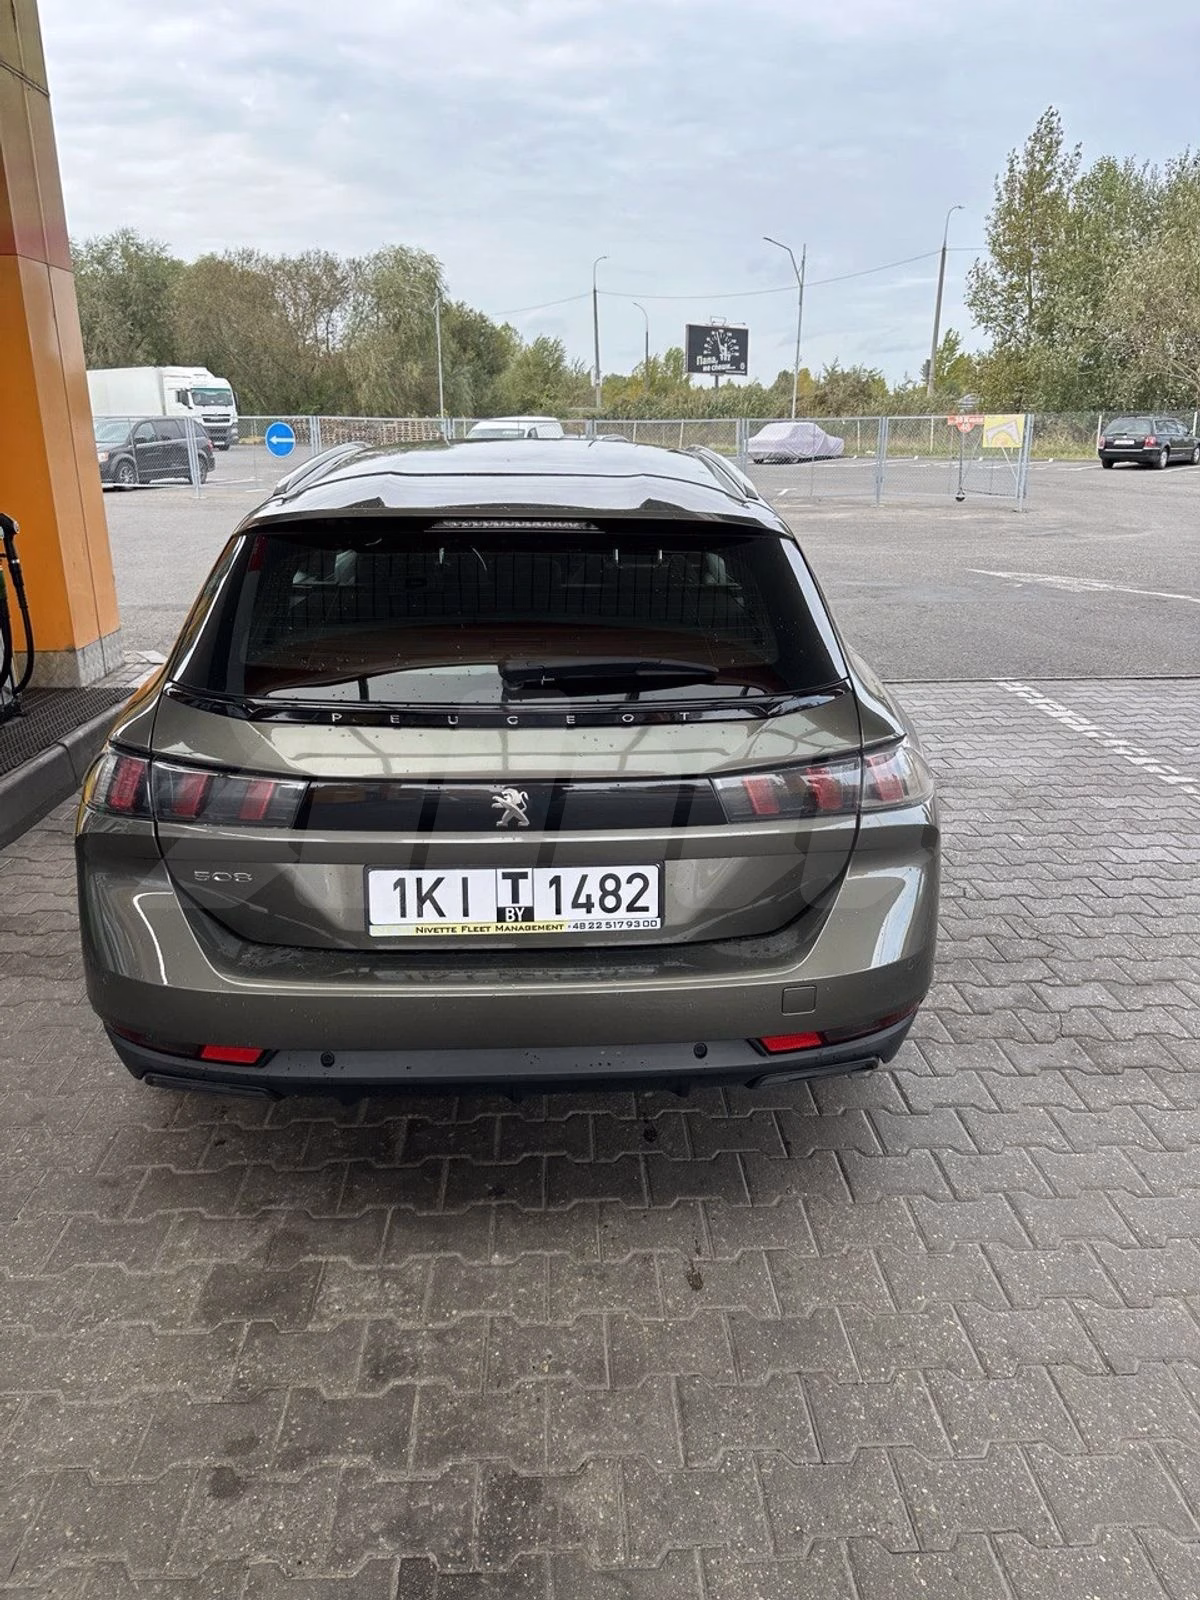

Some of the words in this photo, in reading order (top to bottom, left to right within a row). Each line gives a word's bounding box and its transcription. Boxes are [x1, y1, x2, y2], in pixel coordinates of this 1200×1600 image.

[331, 711, 690, 725] PEUGEOT
[194, 871, 252, 882] 508
[501, 871, 529, 905] T
[548, 872, 650, 916] 1482
[504, 907, 525, 923] BY
[461, 925, 492, 934] FLEET
[495, 923, 564, 933] MANAGEMENT
